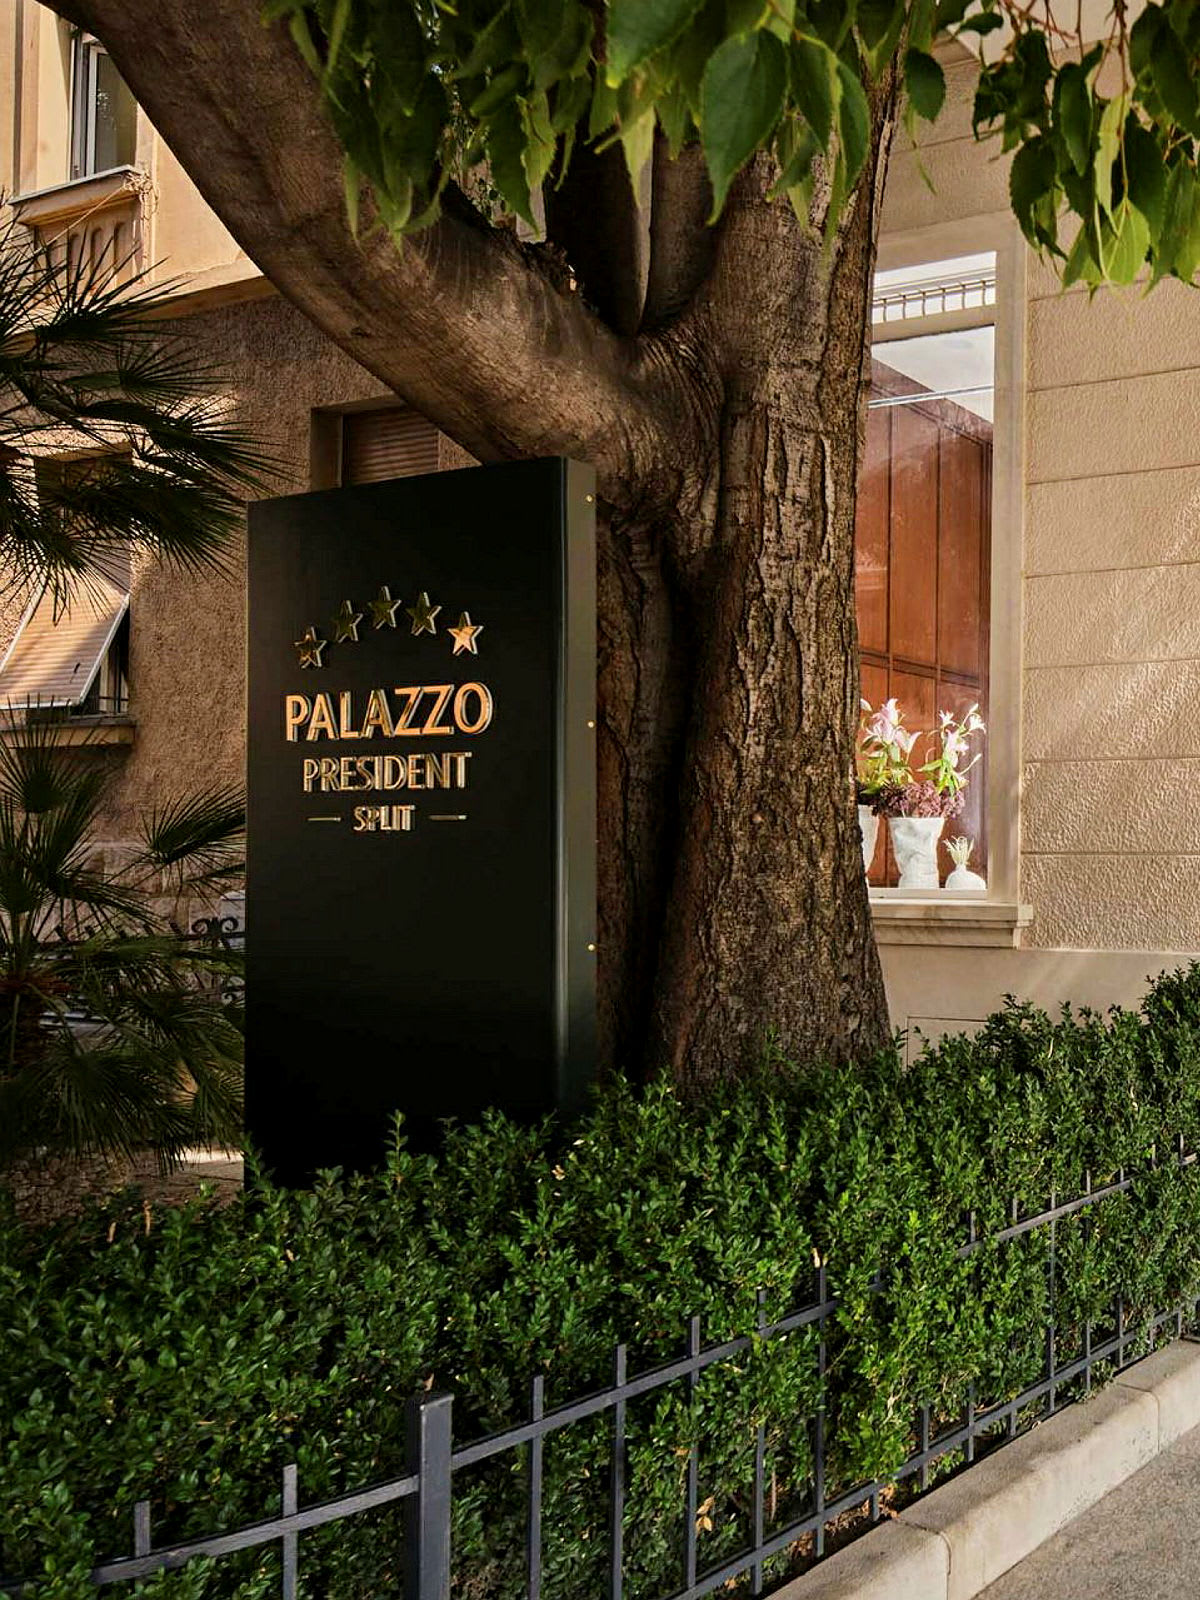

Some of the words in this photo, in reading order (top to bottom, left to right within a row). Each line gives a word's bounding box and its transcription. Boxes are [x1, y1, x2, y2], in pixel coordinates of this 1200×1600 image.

[286, 682, 492, 741] PALAZZO
[303, 752, 472, 791] PRESIDENT
[353, 805, 415, 831] SPLIT
